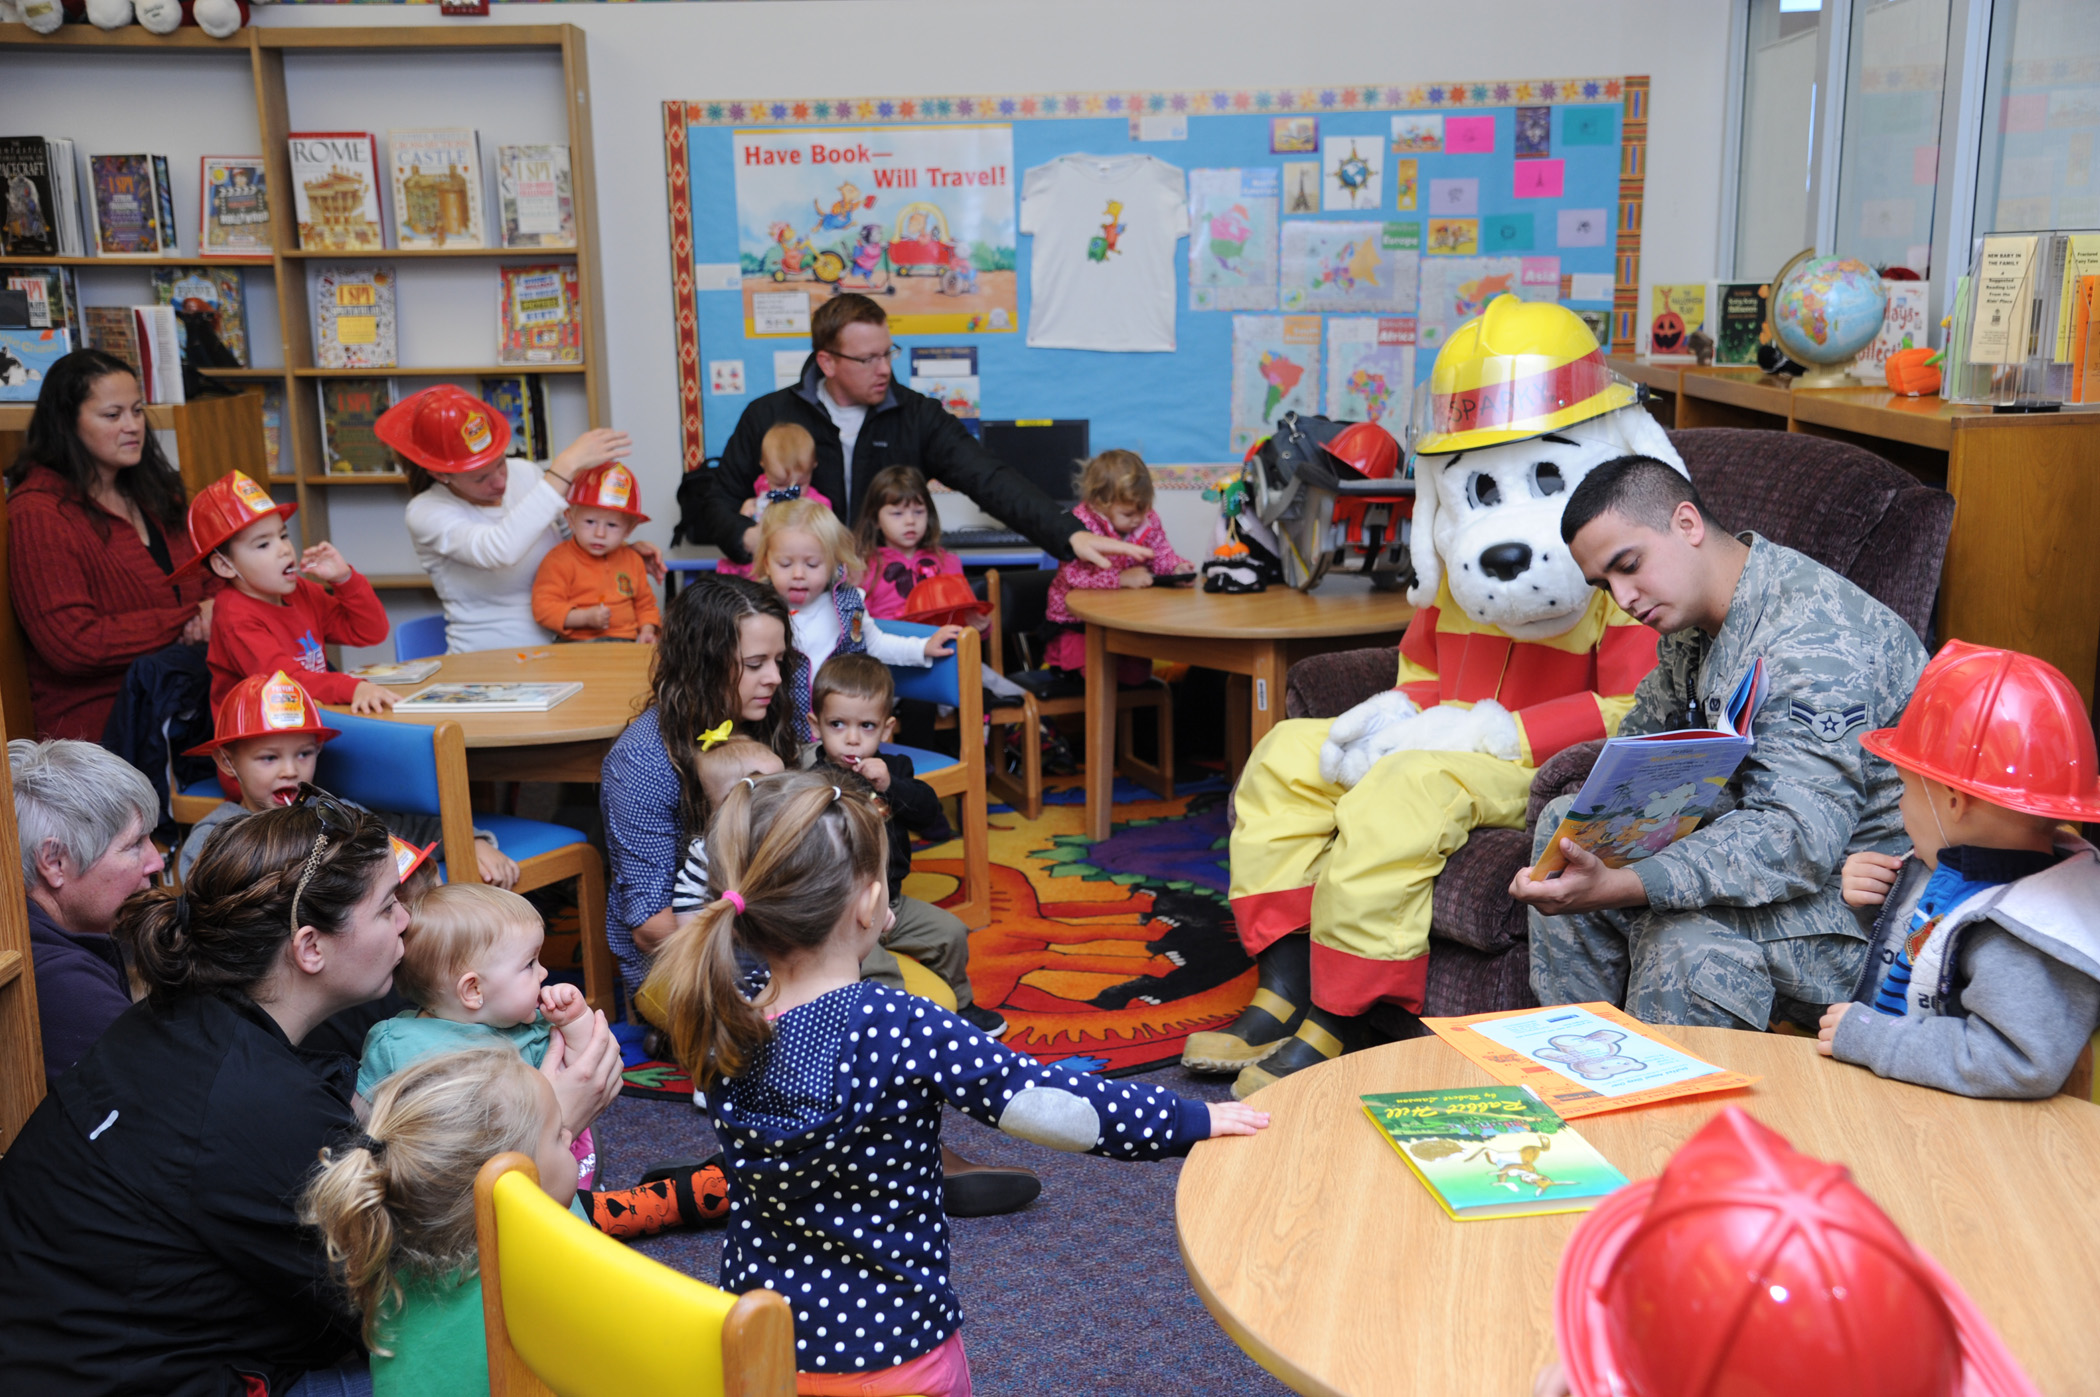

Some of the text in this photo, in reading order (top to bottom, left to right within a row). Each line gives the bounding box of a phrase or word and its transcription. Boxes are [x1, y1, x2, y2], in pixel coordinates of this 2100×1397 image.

[292, 140, 368, 163] ROME
[397, 149, 466, 165] CASTLE
[744, 145, 801, 166] Have
[526, 161, 551, 181] SPY
[873, 166, 1006, 189] Will Travel!
[1382, 235, 1418, 248] Europe
[1524, 269, 1558, 282] Asia
[348, 286, 371, 306] SPY
[1379, 330, 1415, 343] Africa
[1384, 1100, 1527, 1119] Rabbit Hill
[1396, 1096, 1439, 1104] Lawson
